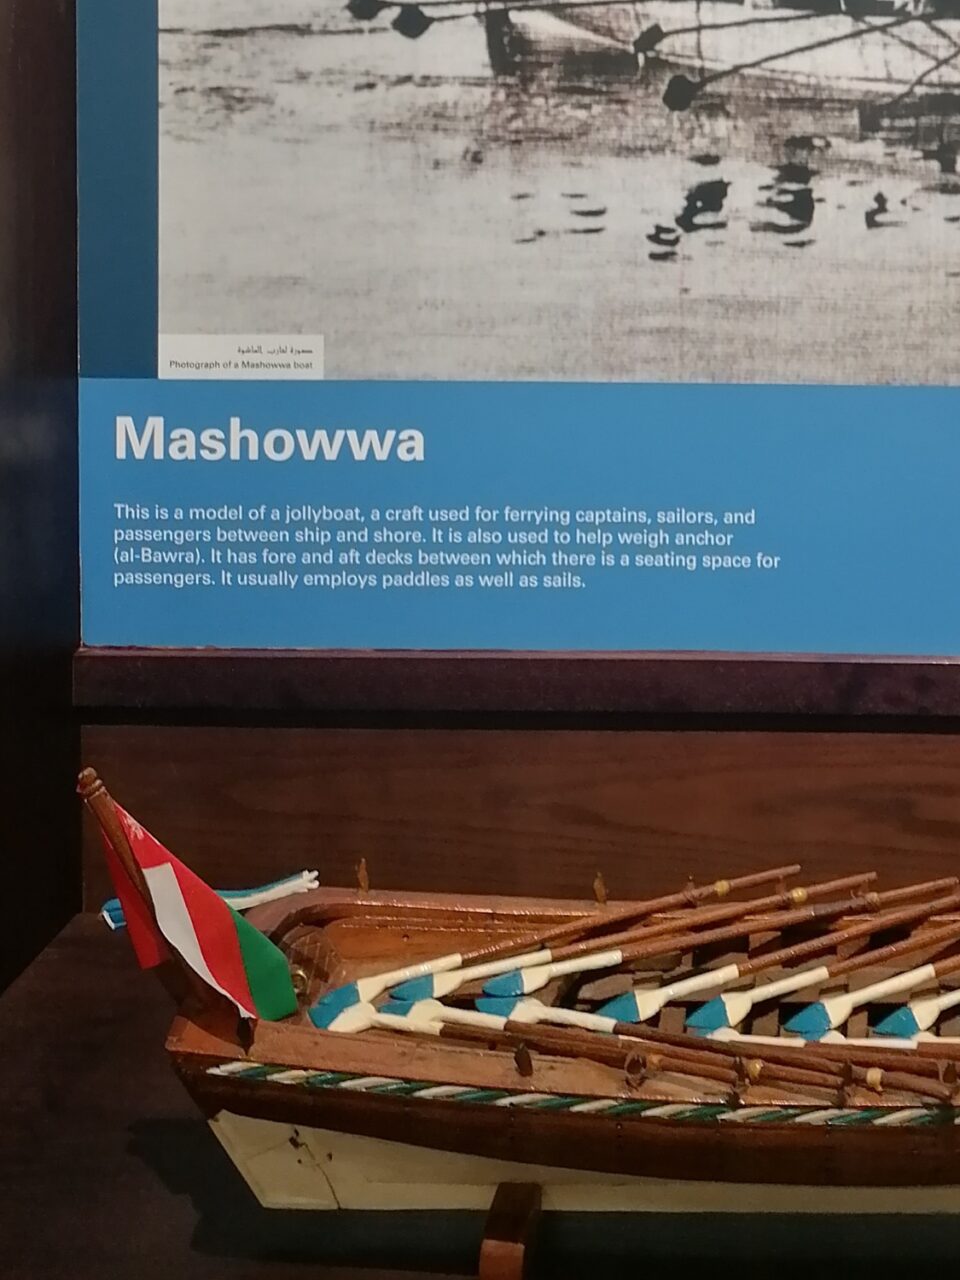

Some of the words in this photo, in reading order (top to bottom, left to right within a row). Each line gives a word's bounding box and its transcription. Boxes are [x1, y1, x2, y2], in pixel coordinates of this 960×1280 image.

[169, 360, 220, 370] Photograph
[222, 360, 232, 369] of
[241, 360, 291, 369] Mashowwa
[294, 360, 313, 369] boat
[113, 416, 426, 462] Mashowwa
[113, 502, 150, 520] This
[155, 504, 169, 520] is
[173, 507, 184, 520] a
[189, 504, 243, 521] model
[248, 504, 267, 521] of
[270, 508, 280, 521] a
[285, 504, 365, 524] jollyboat,
[370, 508, 381, 521] a
[385, 505, 424, 522] craft
[428, 505, 470, 522] used
[474, 505, 500, 522] for
[503, 506, 571, 526] ferrying
[575, 507, 652, 526] captains,
[656, 507, 718, 526] sailors,
[723, 508, 756, 525] and
[113, 528, 212, 545] passengers
[216, 526, 290, 542] between
[295, 526, 331, 546] ship
[336, 527, 368, 543] and
[373, 527, 426, 543] shore.
[432, 527, 444, 543] It
[448, 527, 463, 543] is
[467, 527, 503, 544] also
[507, 528, 549, 544] used
[553, 530, 571, 544] to
[576, 528, 613, 548] help
[617, 528, 670, 549] weigh
[674, 529, 734, 546] anchor
[113, 546, 205, 565] (al-Bawra).
[211, 547, 222, 564] It
[227, 548, 257, 564] has
[262, 547, 297, 565] fore
[301, 548, 333, 564] and
[338, 548, 361, 565] aft
[365, 548, 413, 565] decks
[418, 549, 491, 565] between
[496, 549, 546, 566] which
[551, 549, 596, 566] there
[601, 550, 616, 567] is
[619, 554, 630, 567] a
[634, 551, 697, 571] seating
[702, 554, 752, 571] space
[756, 551, 781, 569] for
[113, 572, 216, 589] passengers.
[221, 569, 233, 586] It
[237, 569, 299, 589] usually
[303, 570, 378, 590] employs
[382, 570, 450, 590] paddles
[454, 574, 474, 588] as
[478, 571, 514, 588] well
[518, 575, 538, 588] as
[542, 571, 586, 588] sails.
